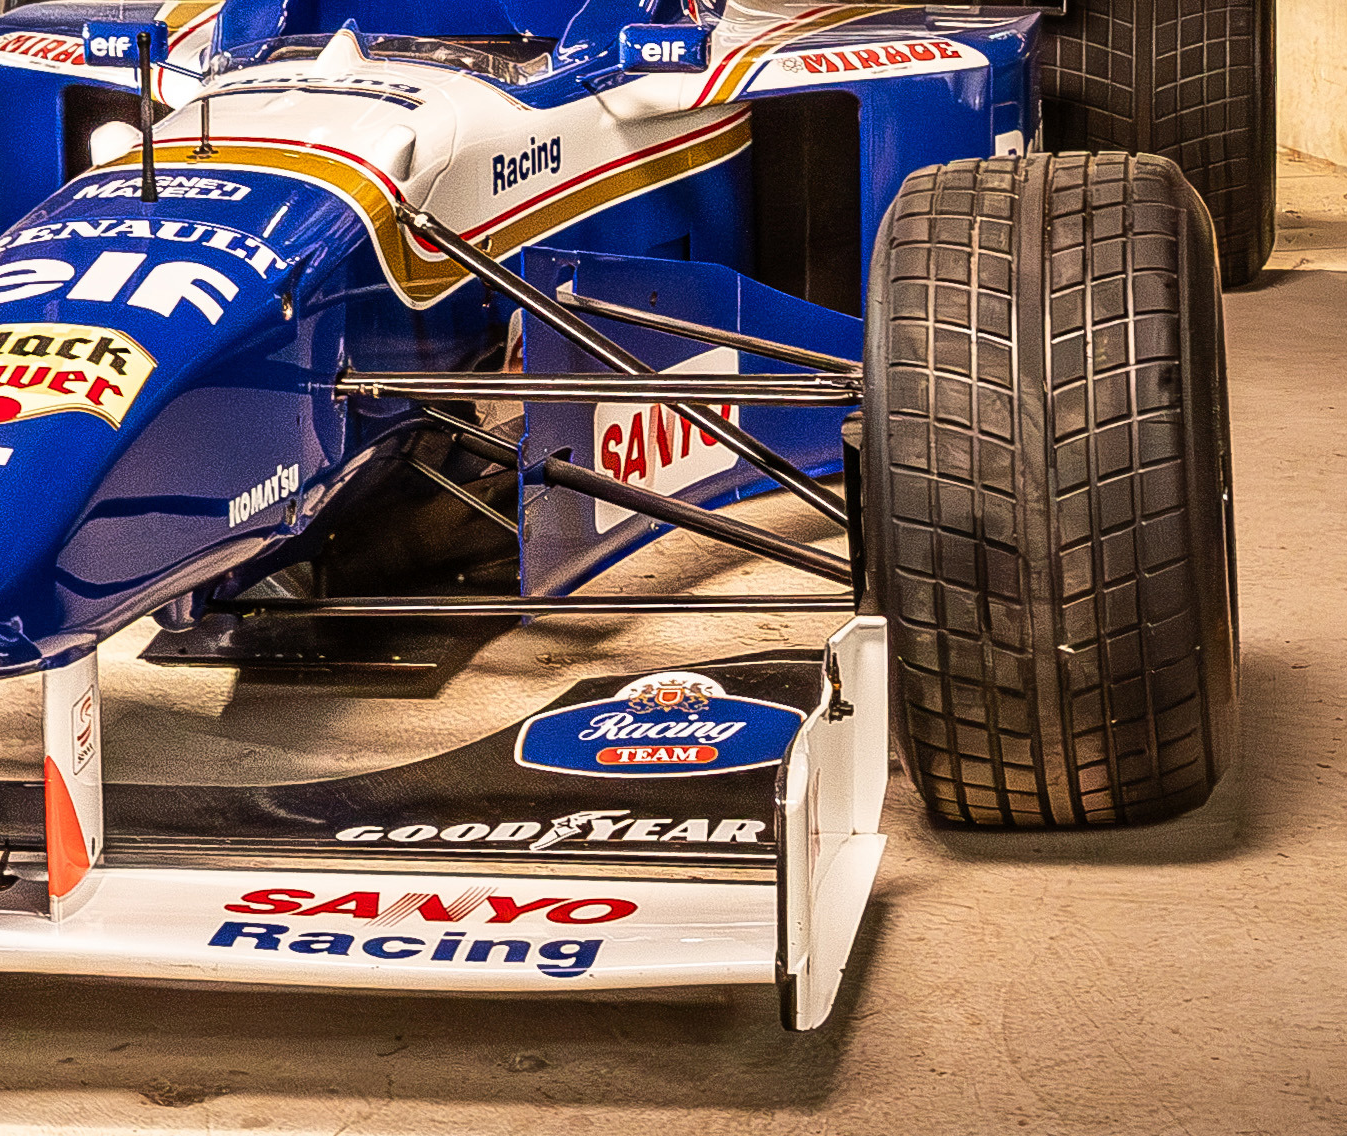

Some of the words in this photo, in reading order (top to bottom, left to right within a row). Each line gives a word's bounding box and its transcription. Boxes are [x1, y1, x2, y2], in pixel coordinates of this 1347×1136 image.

[90, 36, 132, 58] elf
[641, 41, 685, 63] elf
[799, 41, 963, 75] MIRAGE
[492, 135, 562, 196] Racing
[228, 463, 300, 529] KOMATSU
[578, 710, 747, 745] Racing
[616, 746, 698, 764] TEAM
[223, 886, 639, 926] SANYO
[207, 920, 606, 978] Racing
